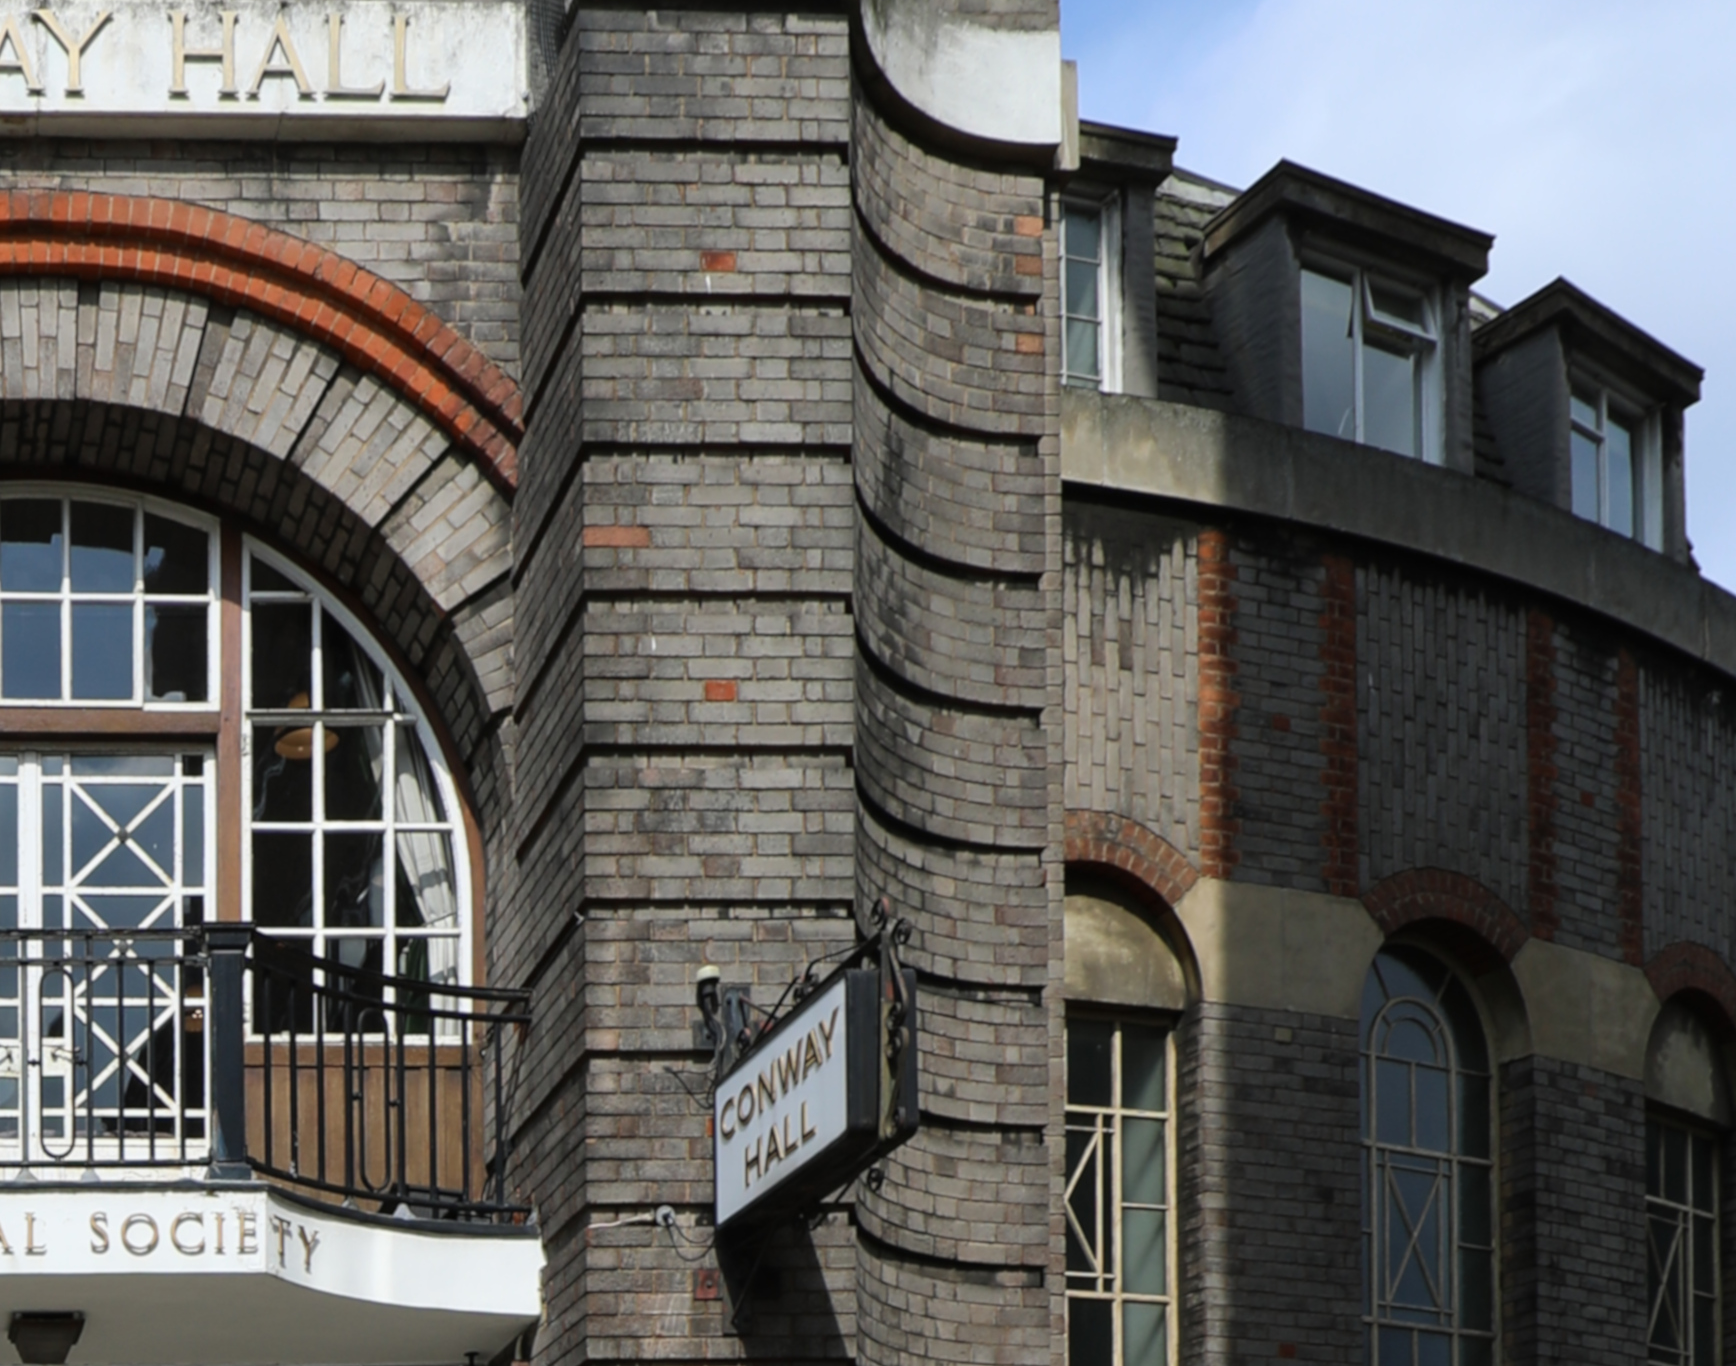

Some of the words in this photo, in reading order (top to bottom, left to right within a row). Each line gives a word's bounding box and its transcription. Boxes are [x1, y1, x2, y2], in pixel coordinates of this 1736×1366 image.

[167, 9, 452, 102] HALL
[720, 1006, 841, 1141] CONWAY
[743, 1101, 817, 1191] HALL
[89, 1211, 321, 1274] SOCIETY
